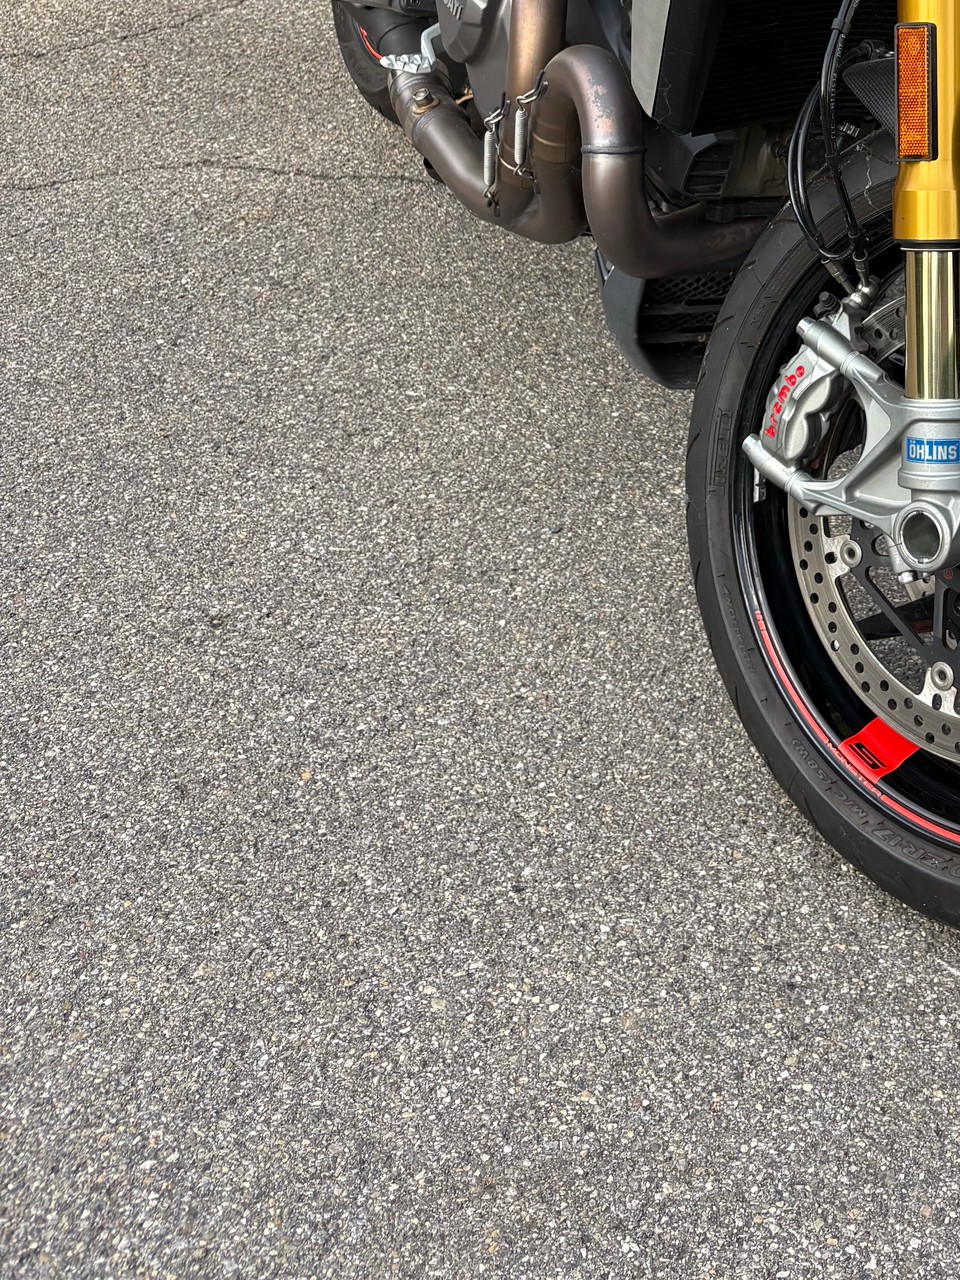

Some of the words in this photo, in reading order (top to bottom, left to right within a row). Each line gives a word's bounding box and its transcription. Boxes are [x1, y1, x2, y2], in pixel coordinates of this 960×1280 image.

[764, 365, 805, 438] brembo
[909, 440, 957, 461] ÖHLINS
[827, 742, 882, 797] MONSTER
